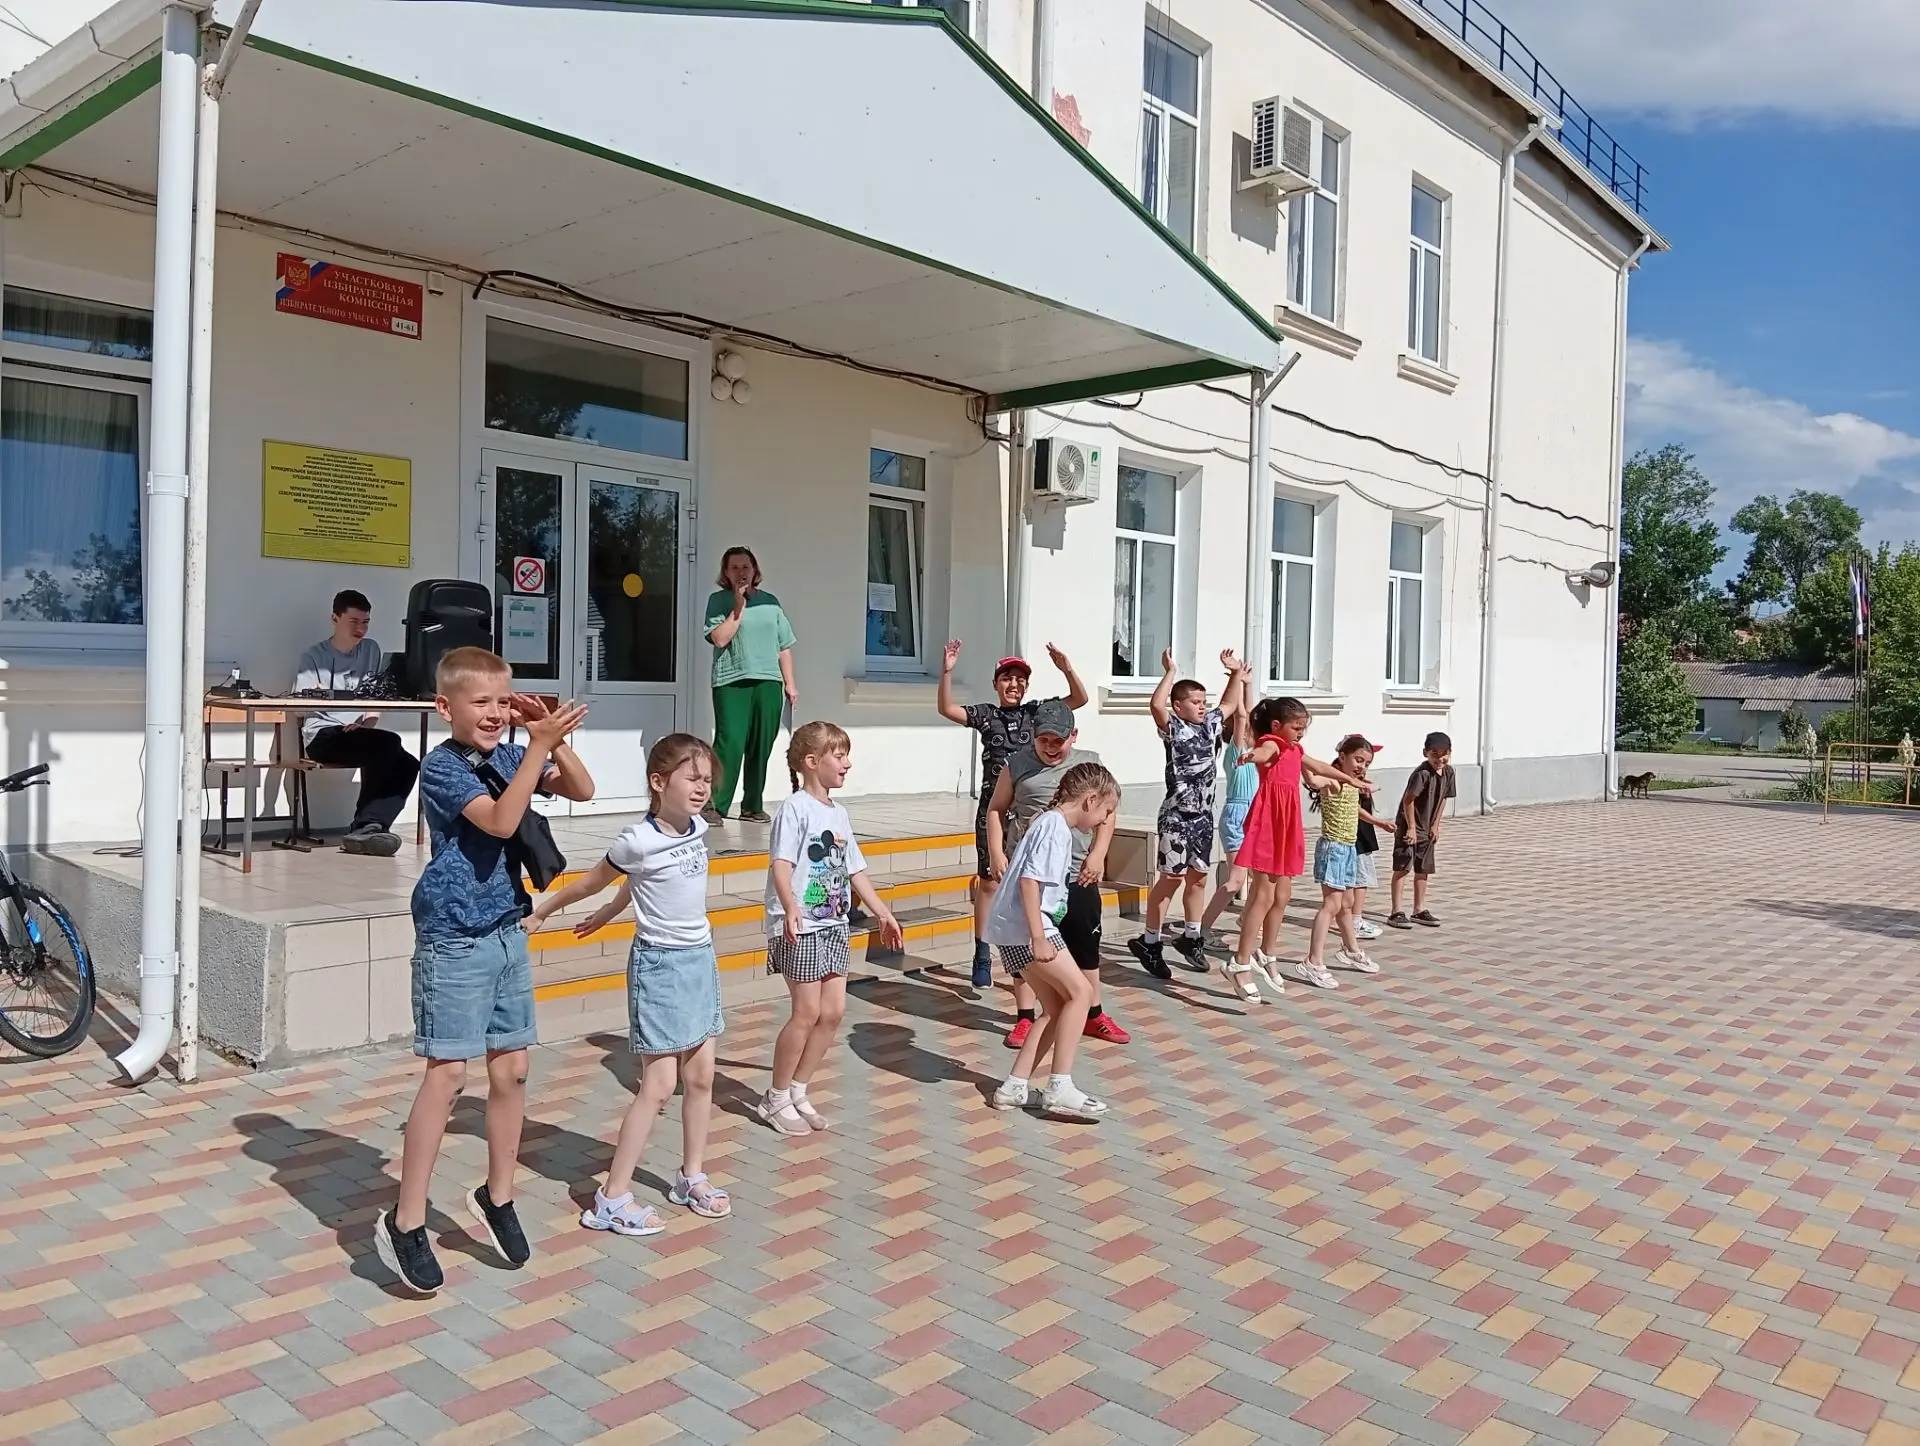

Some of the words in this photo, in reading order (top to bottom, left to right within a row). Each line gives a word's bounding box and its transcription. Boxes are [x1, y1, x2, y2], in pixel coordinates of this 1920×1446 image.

[323, 279, 414, 307] ИЗБИРАТЕЛЬНАЯ
[334, 270, 405, 294] УЧАСТКОВАЯ
[279, 298, 346, 318] ИЗБИРАТЕЛЬНОГО
[339, 294, 399, 314] КОМИССИЯ
